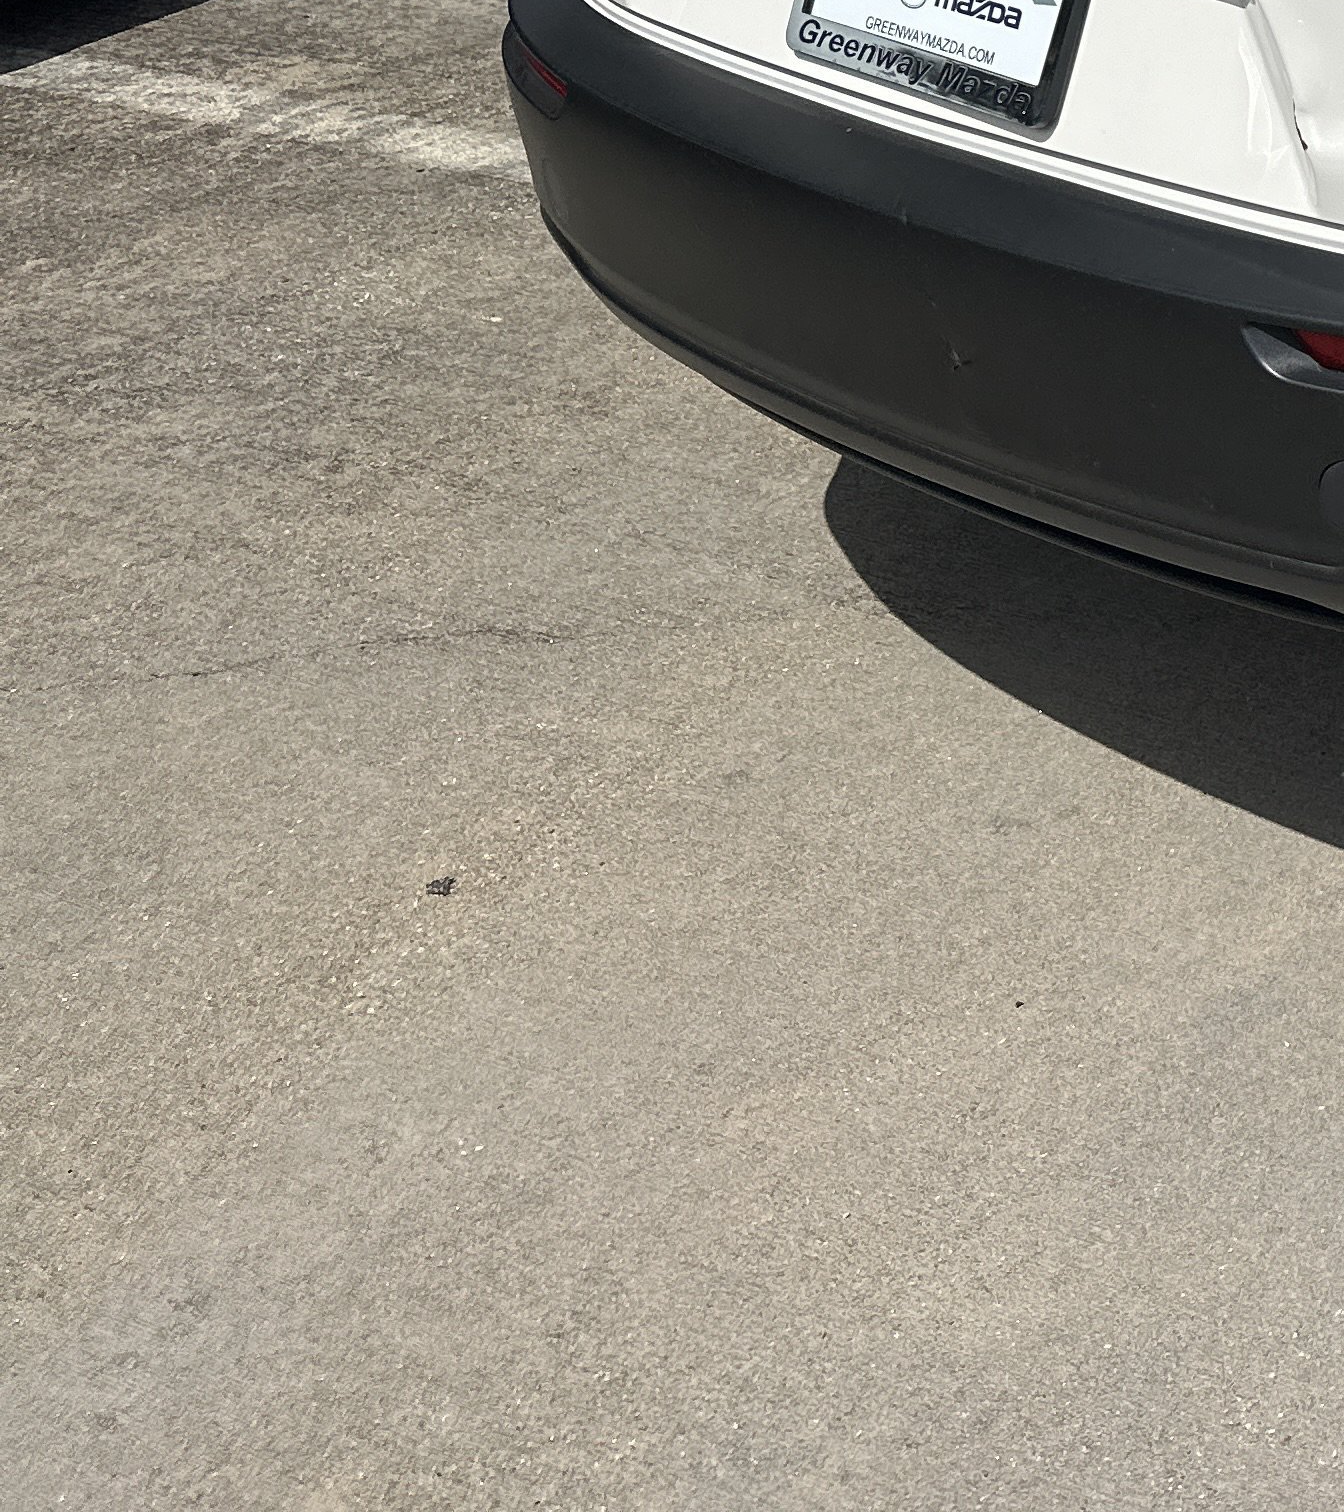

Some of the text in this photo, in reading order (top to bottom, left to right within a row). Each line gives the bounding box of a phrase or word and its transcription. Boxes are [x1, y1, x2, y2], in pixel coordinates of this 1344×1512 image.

[799, 18, 1033, 115] Greenway Mazda
[866, 15, 996, 66] GREENWAYMAZDA.COM
